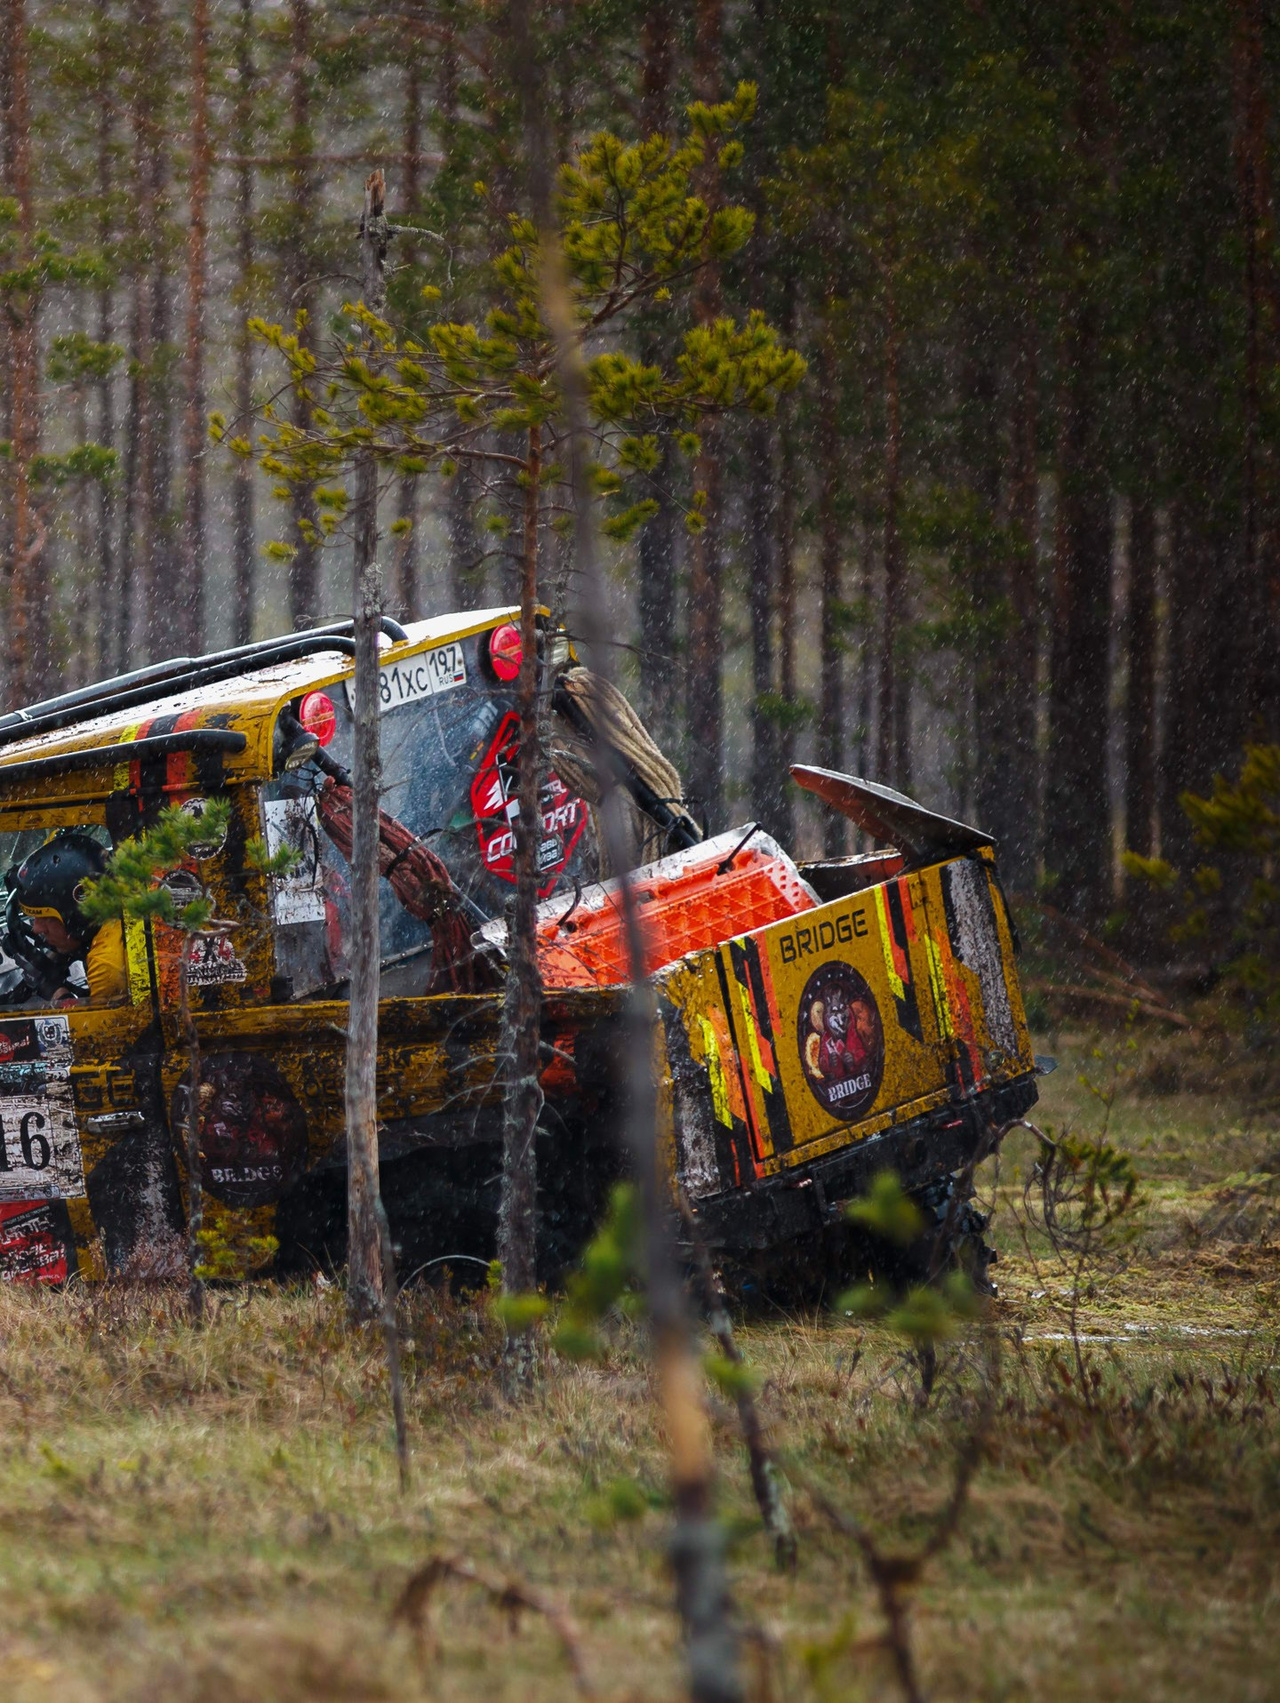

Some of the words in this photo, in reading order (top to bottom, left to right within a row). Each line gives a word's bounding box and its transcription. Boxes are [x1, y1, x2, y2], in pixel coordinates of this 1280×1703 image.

[379, 667, 428, 703] 81XC
[429, 646, 456, 677] 197
[439, 674, 454, 685] RUS
[487, 798, 581, 863] COORT
[780, 909, 868, 964] BRIDGE
[828, 1073, 871, 1102] BRIDGE
[211, 1165, 283, 1183] BRDG
